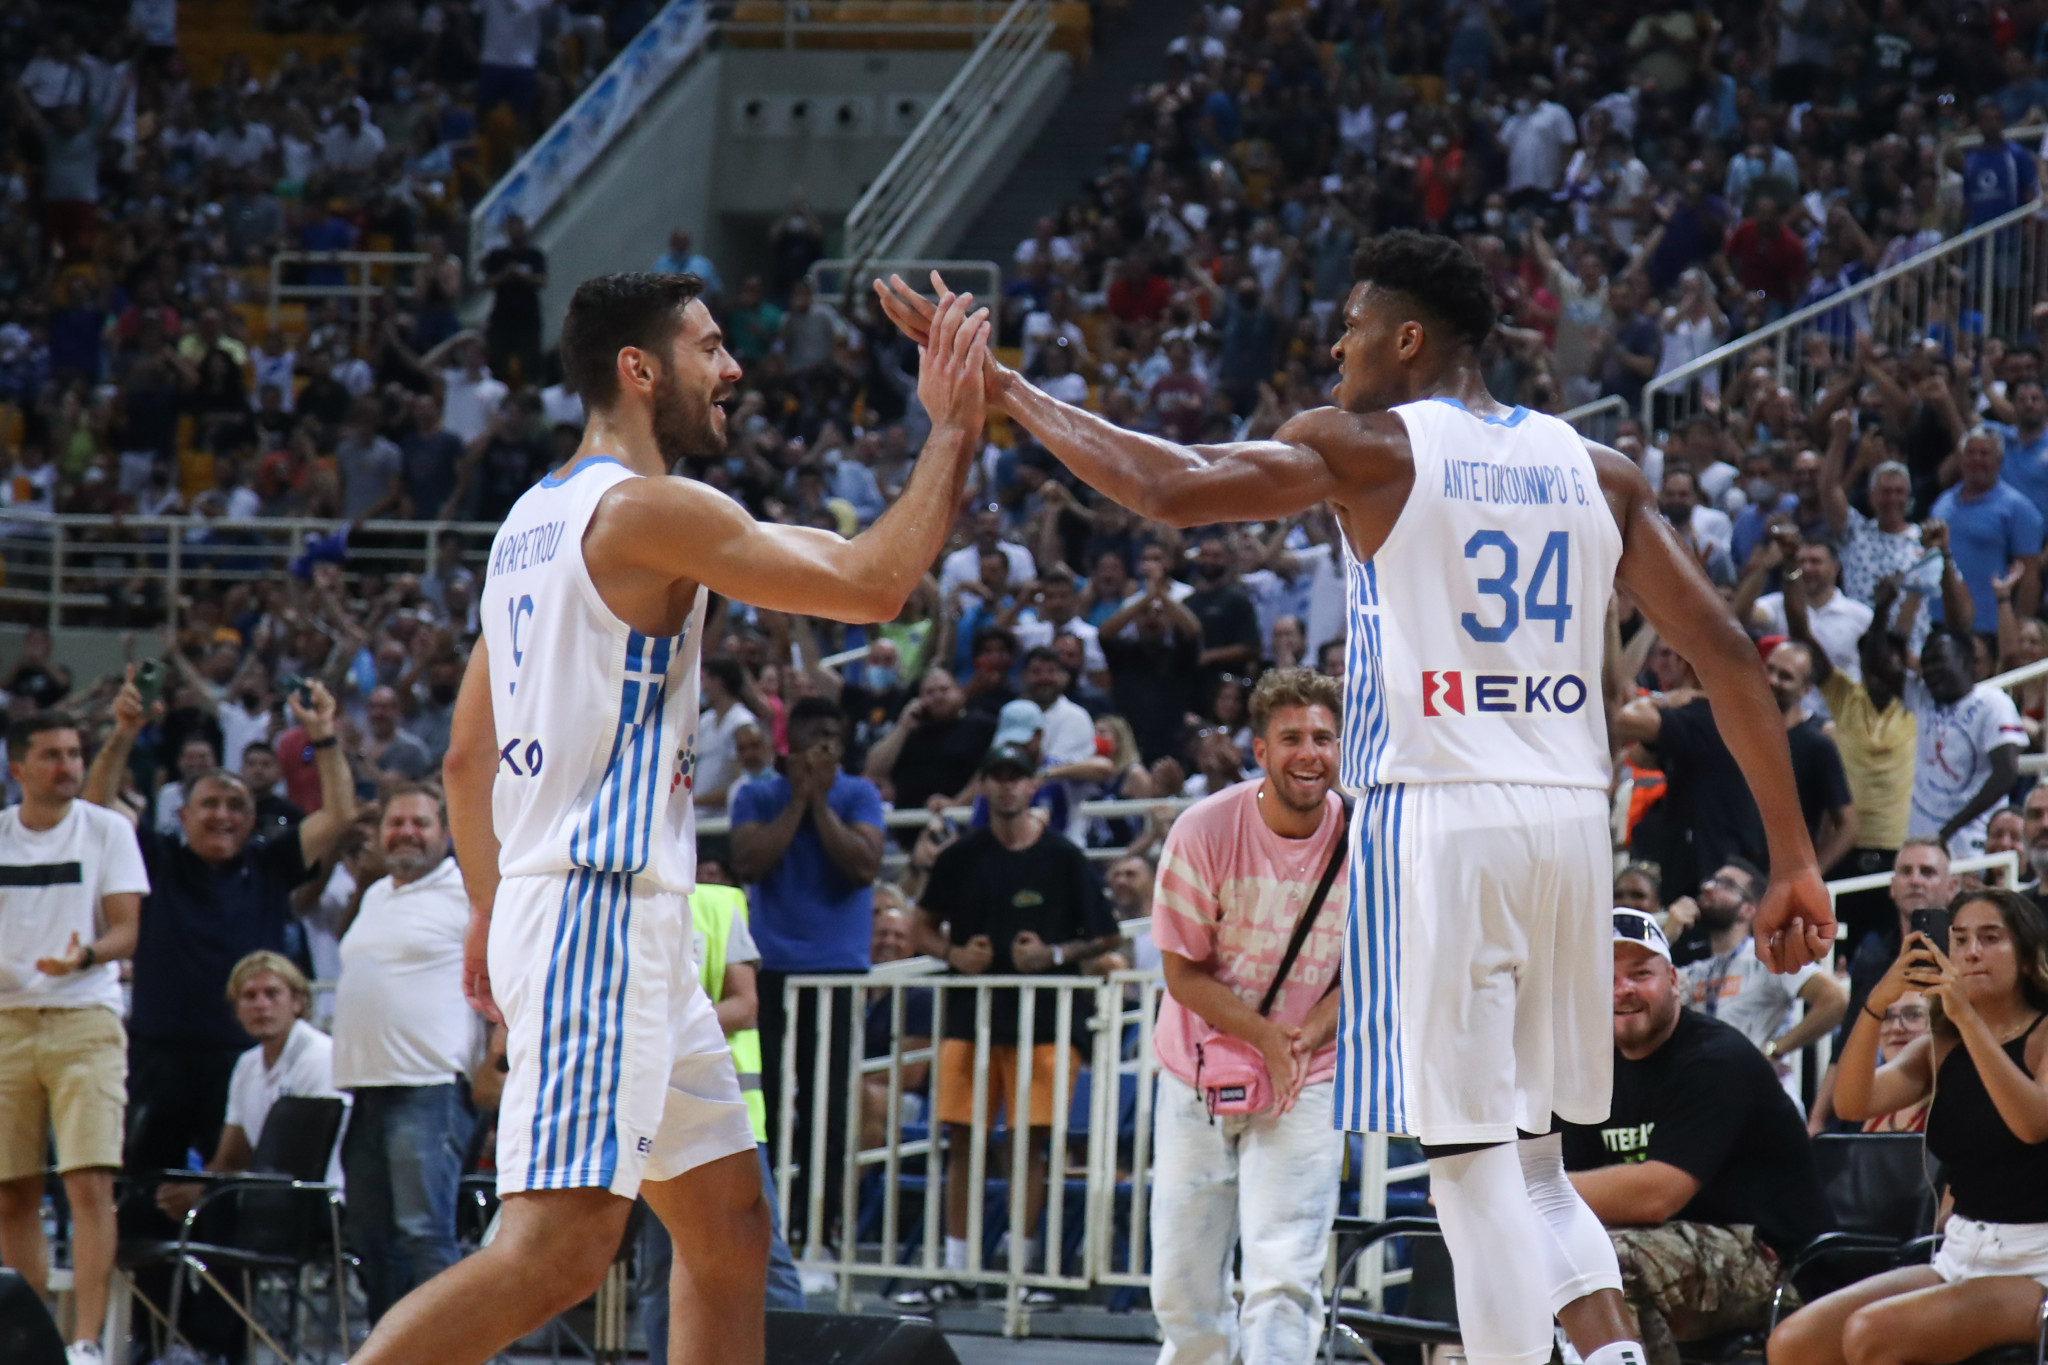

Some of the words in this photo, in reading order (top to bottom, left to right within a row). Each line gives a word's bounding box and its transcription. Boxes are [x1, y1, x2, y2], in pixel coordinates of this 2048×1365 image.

[1444, 458, 1568, 505] ANTETOKOUNMPO
[1571, 466, 1590, 507] G.
[489, 520, 566, 579] APAPETROU
[1461, 529, 1573, 643] 34
[1475, 674, 1587, 714] EKO
[498, 738, 543, 777] KO
